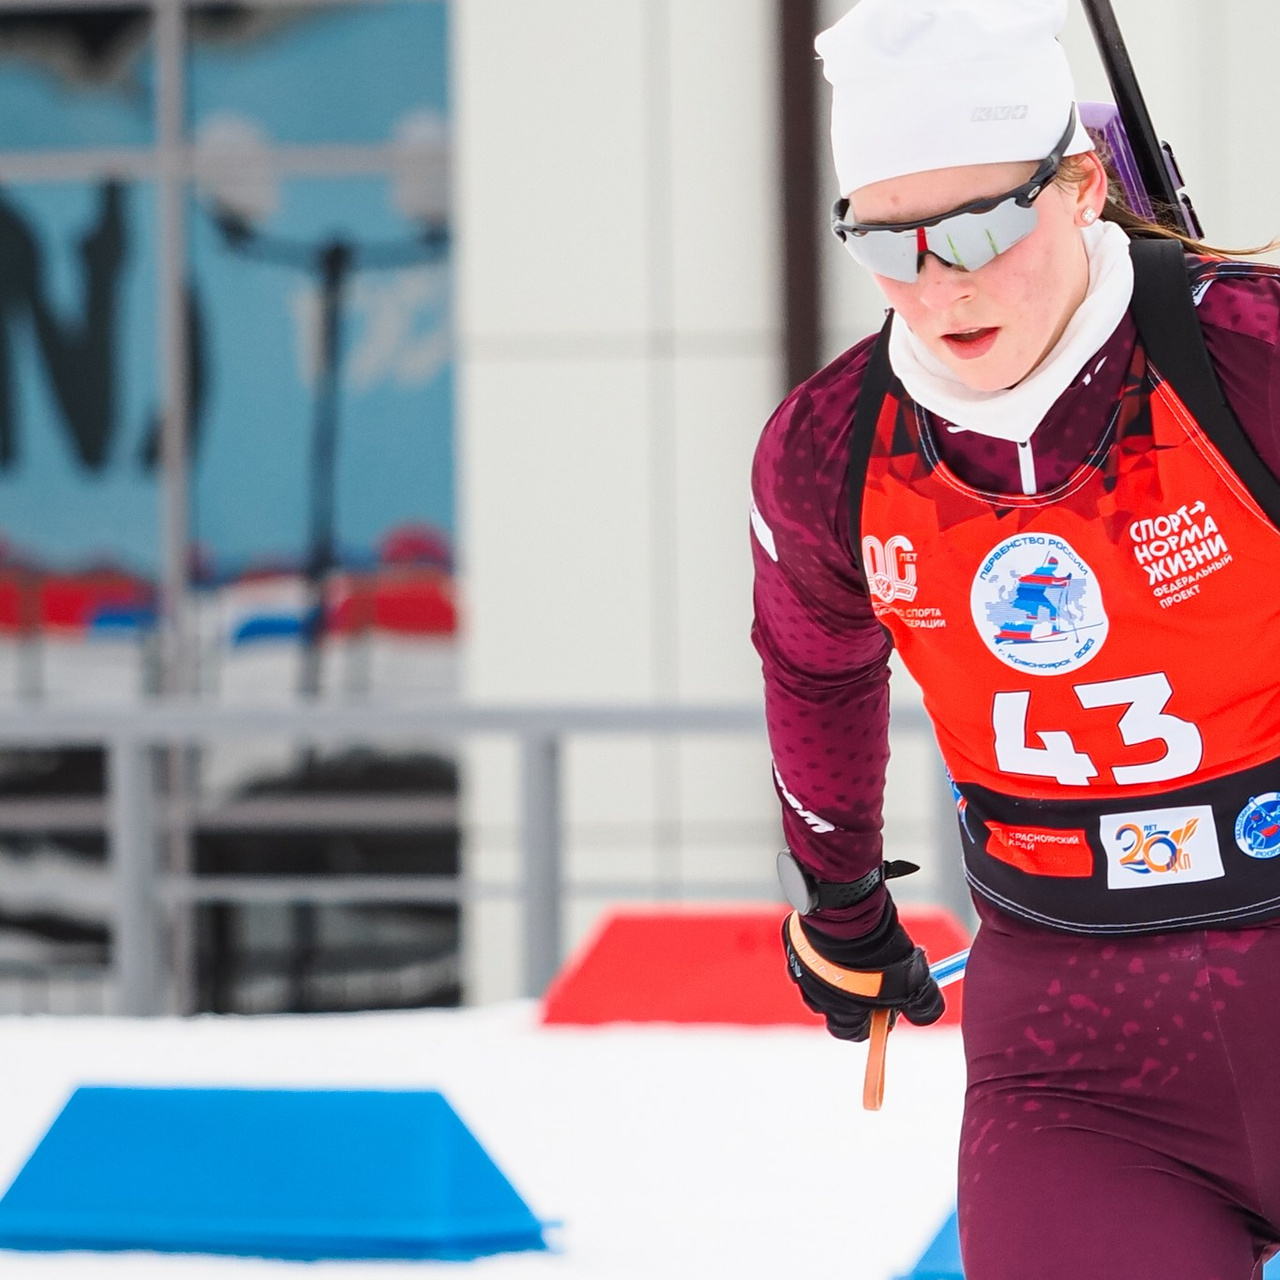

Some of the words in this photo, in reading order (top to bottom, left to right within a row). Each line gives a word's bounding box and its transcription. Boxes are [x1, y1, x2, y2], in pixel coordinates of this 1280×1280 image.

[1129, 505, 1193, 542] СПОРТ
[1133, 515, 1218, 565] НОРМА
[979, 536, 1045, 581] ПЕРВЕНСТВО
[1048, 538, 1088, 576] РОССИИ
[1142, 534, 1228, 586] ЖИЗНИ
[1153, 553, 1233, 597] ФЕДЕРАЛЬНЫЙ
[906, 608, 942, 618] СПОРТА
[1159, 584, 1201, 609] ПРОЕКТ
[1074, 637, 1095, 659] 2023
[991, 671, 1204, 786] 43
